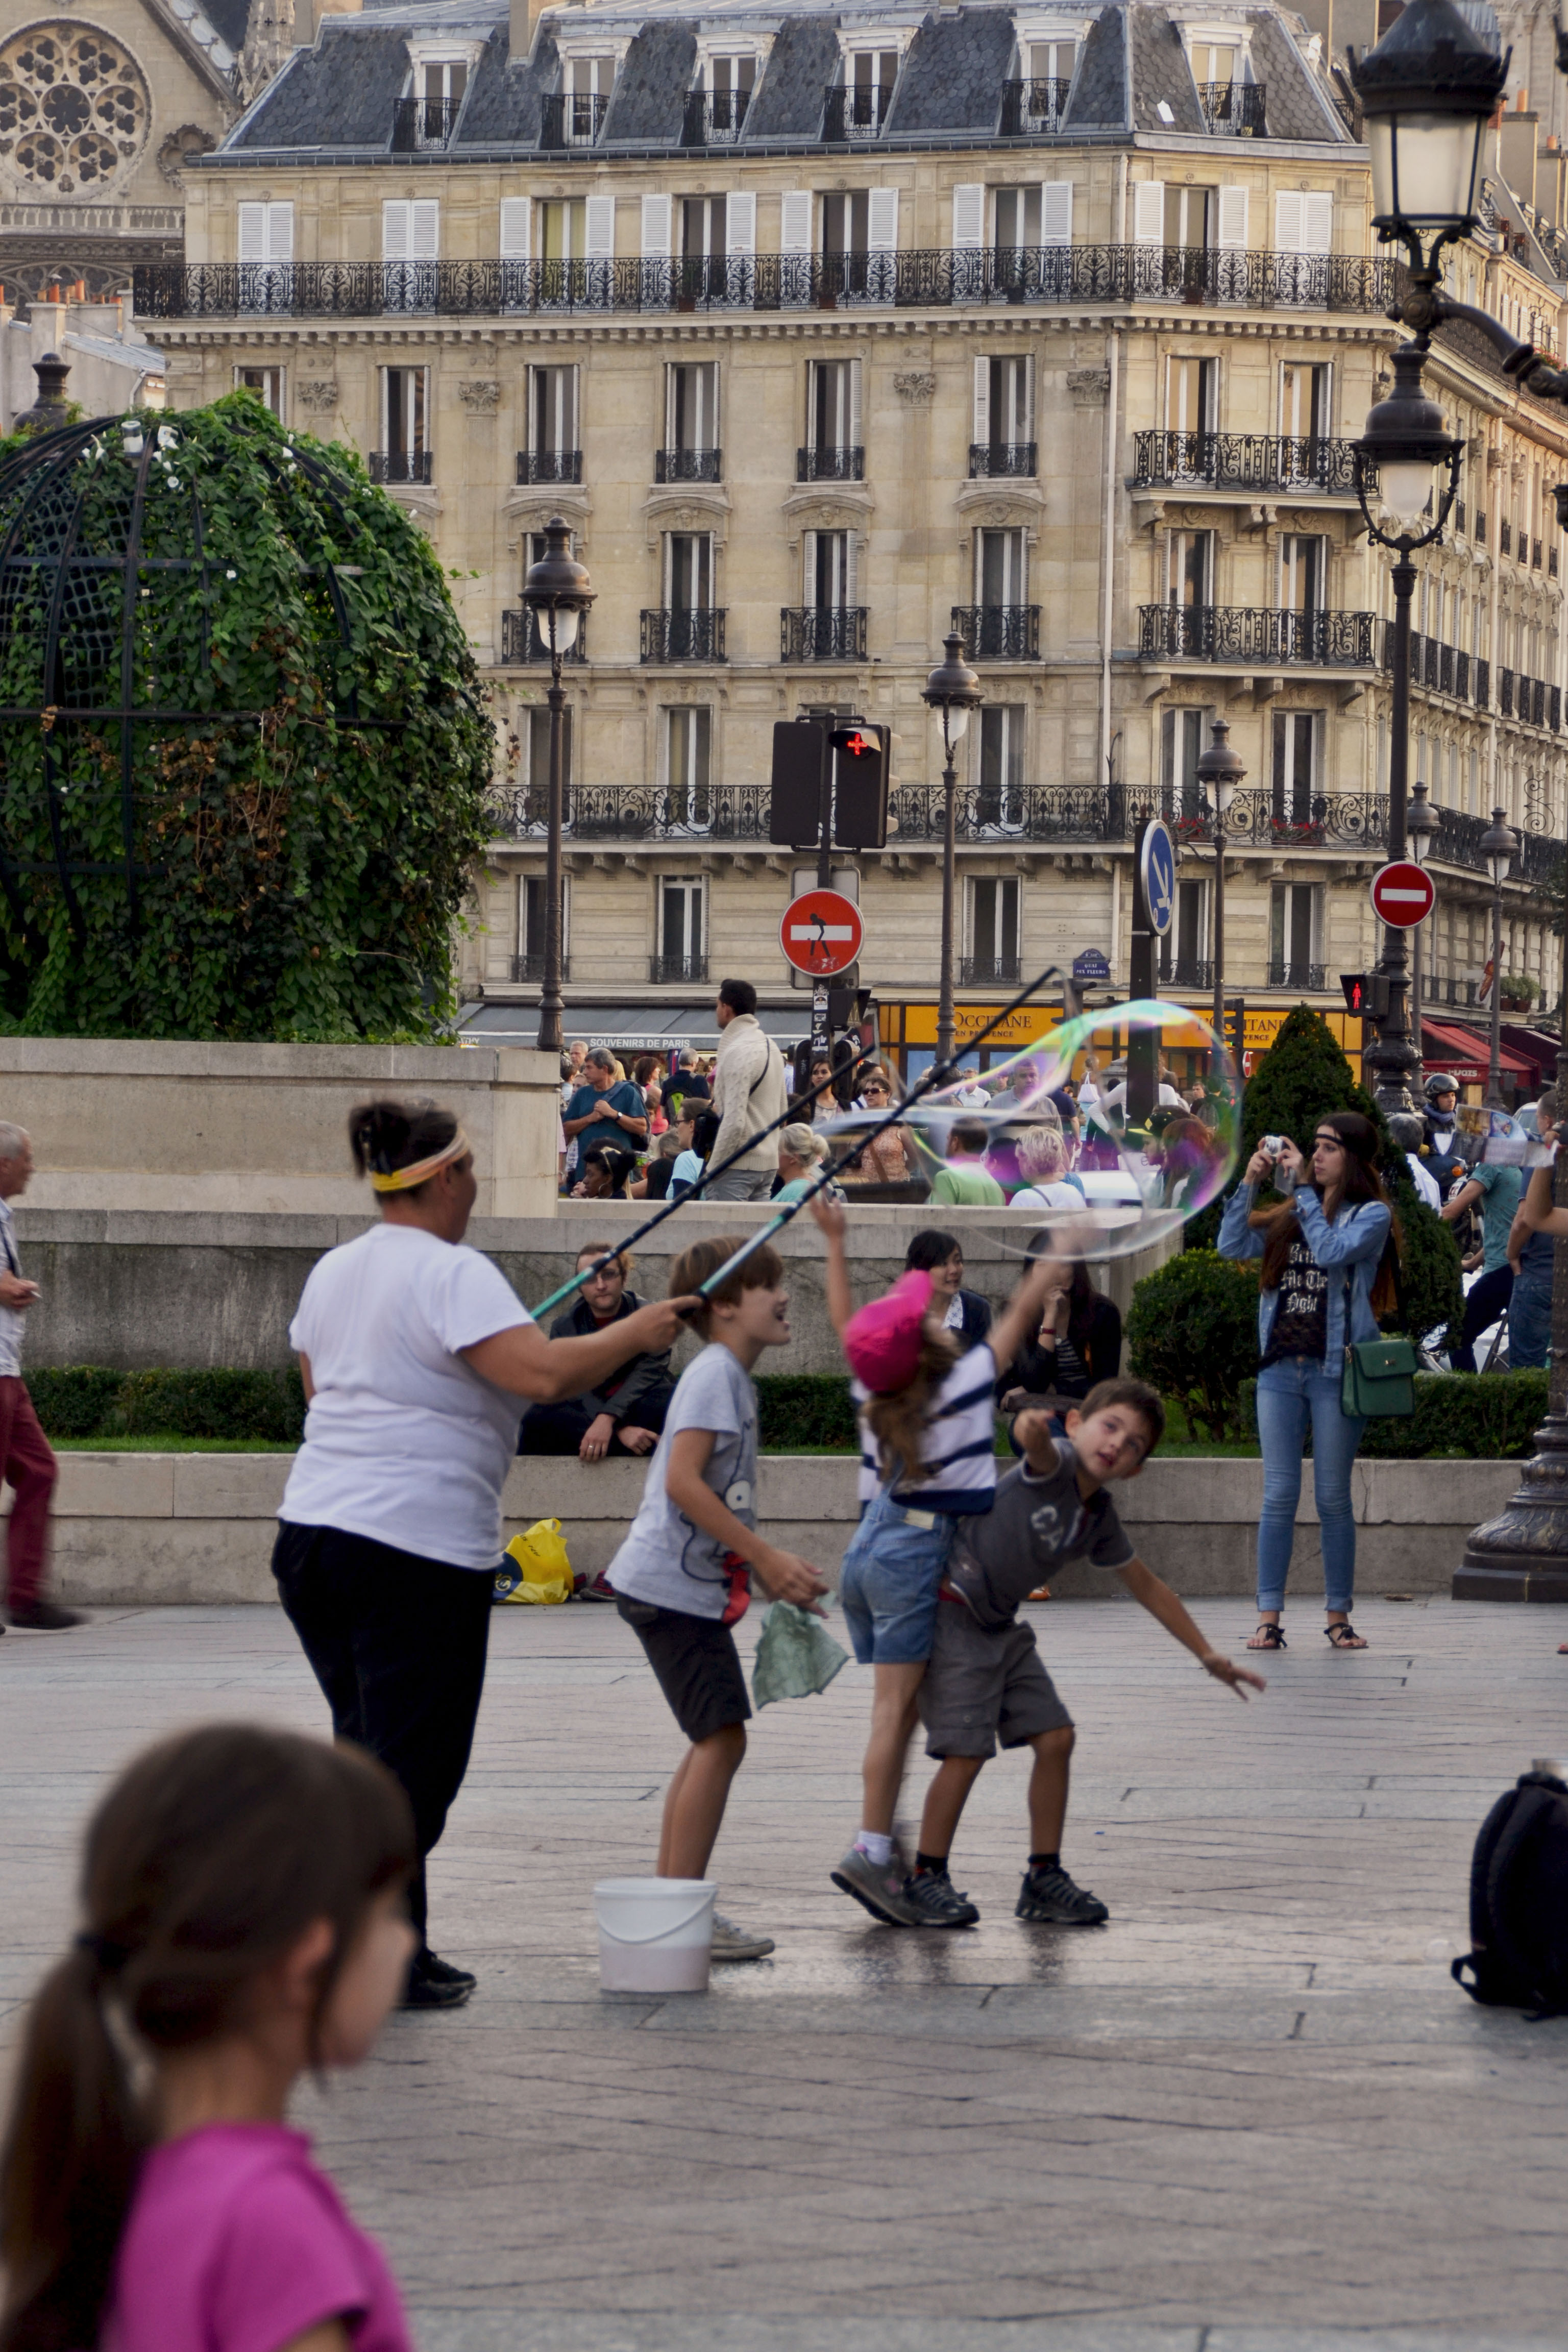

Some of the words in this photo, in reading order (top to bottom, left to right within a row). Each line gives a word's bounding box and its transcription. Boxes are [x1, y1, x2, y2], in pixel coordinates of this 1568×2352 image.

[955, 1012, 1032, 1028] OCCIANE
[590, 1038, 645, 1047] SOUVENIRS
[663, 1039, 691, 1048] PARIS
